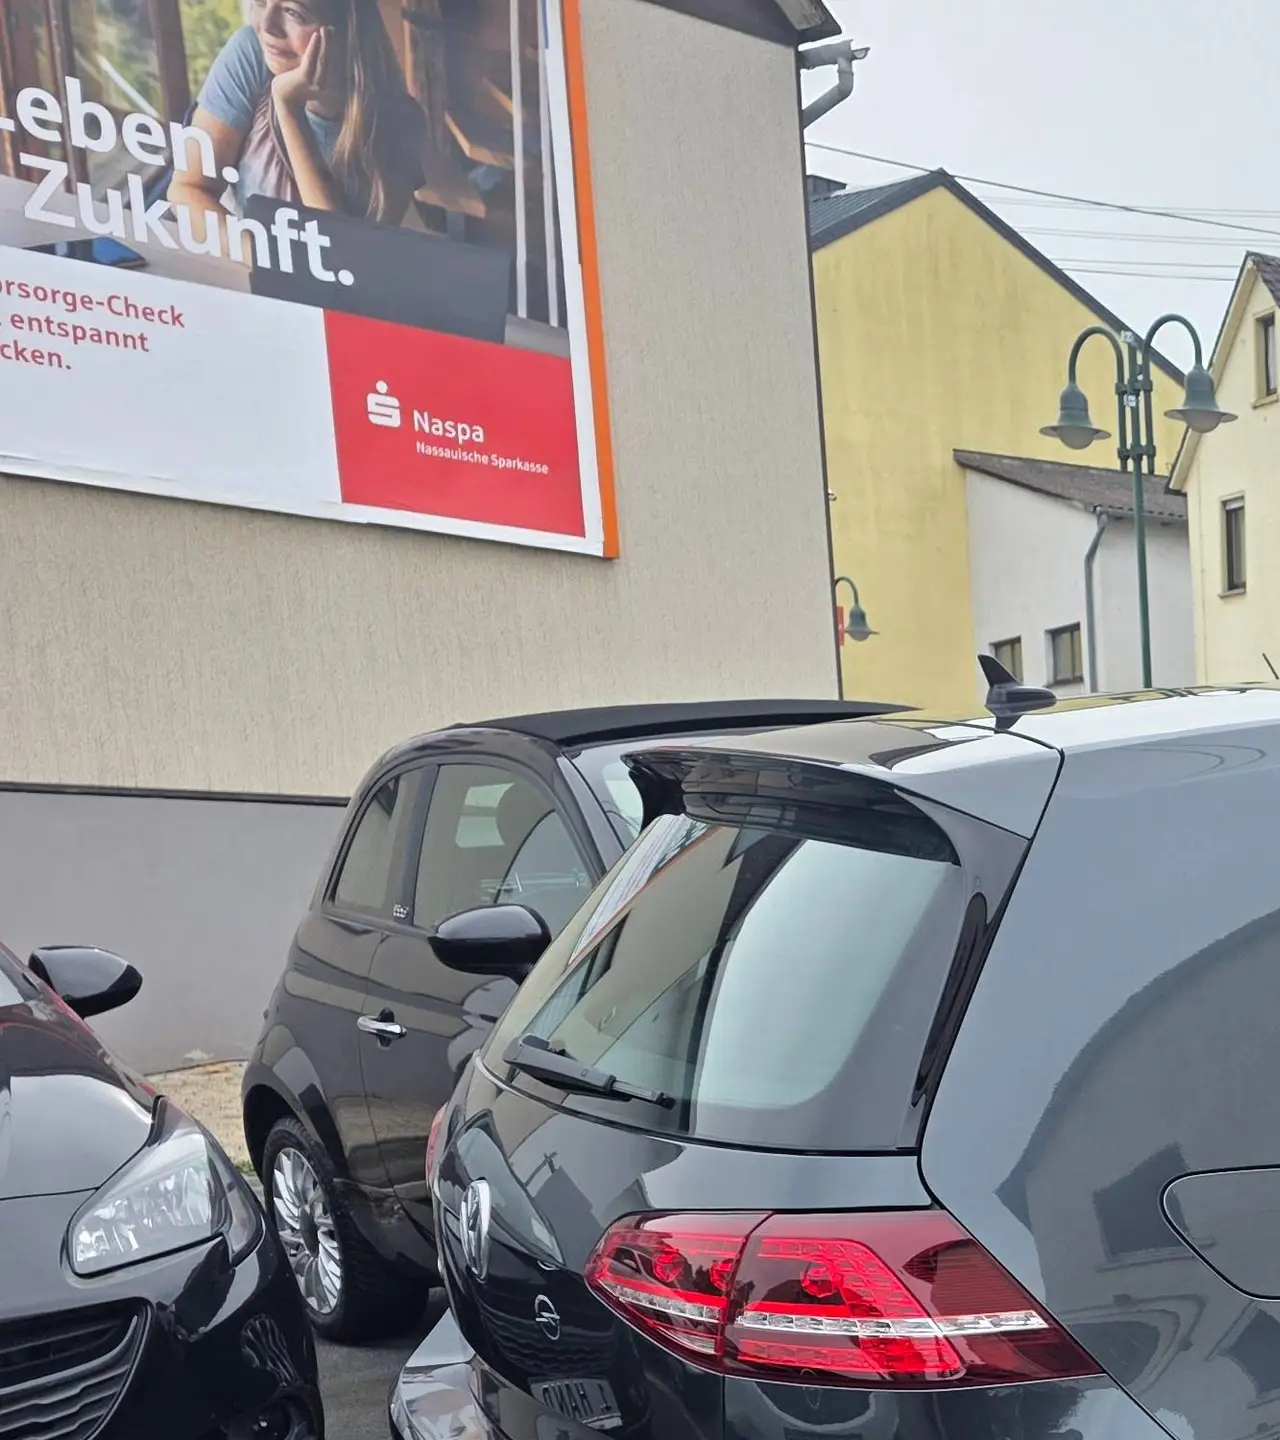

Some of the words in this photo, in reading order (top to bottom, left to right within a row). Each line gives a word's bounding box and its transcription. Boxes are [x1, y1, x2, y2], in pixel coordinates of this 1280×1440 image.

[20, 152, 355, 286] Zukunft.
[0, 279, 185, 328] rsorge-Check
[10, 313, 150, 352] entspannt
[413, 409, 484, 445] Naspa
[416, 440, 489, 465] Nassauische
[490, 453, 549, 475] Sparkasse
